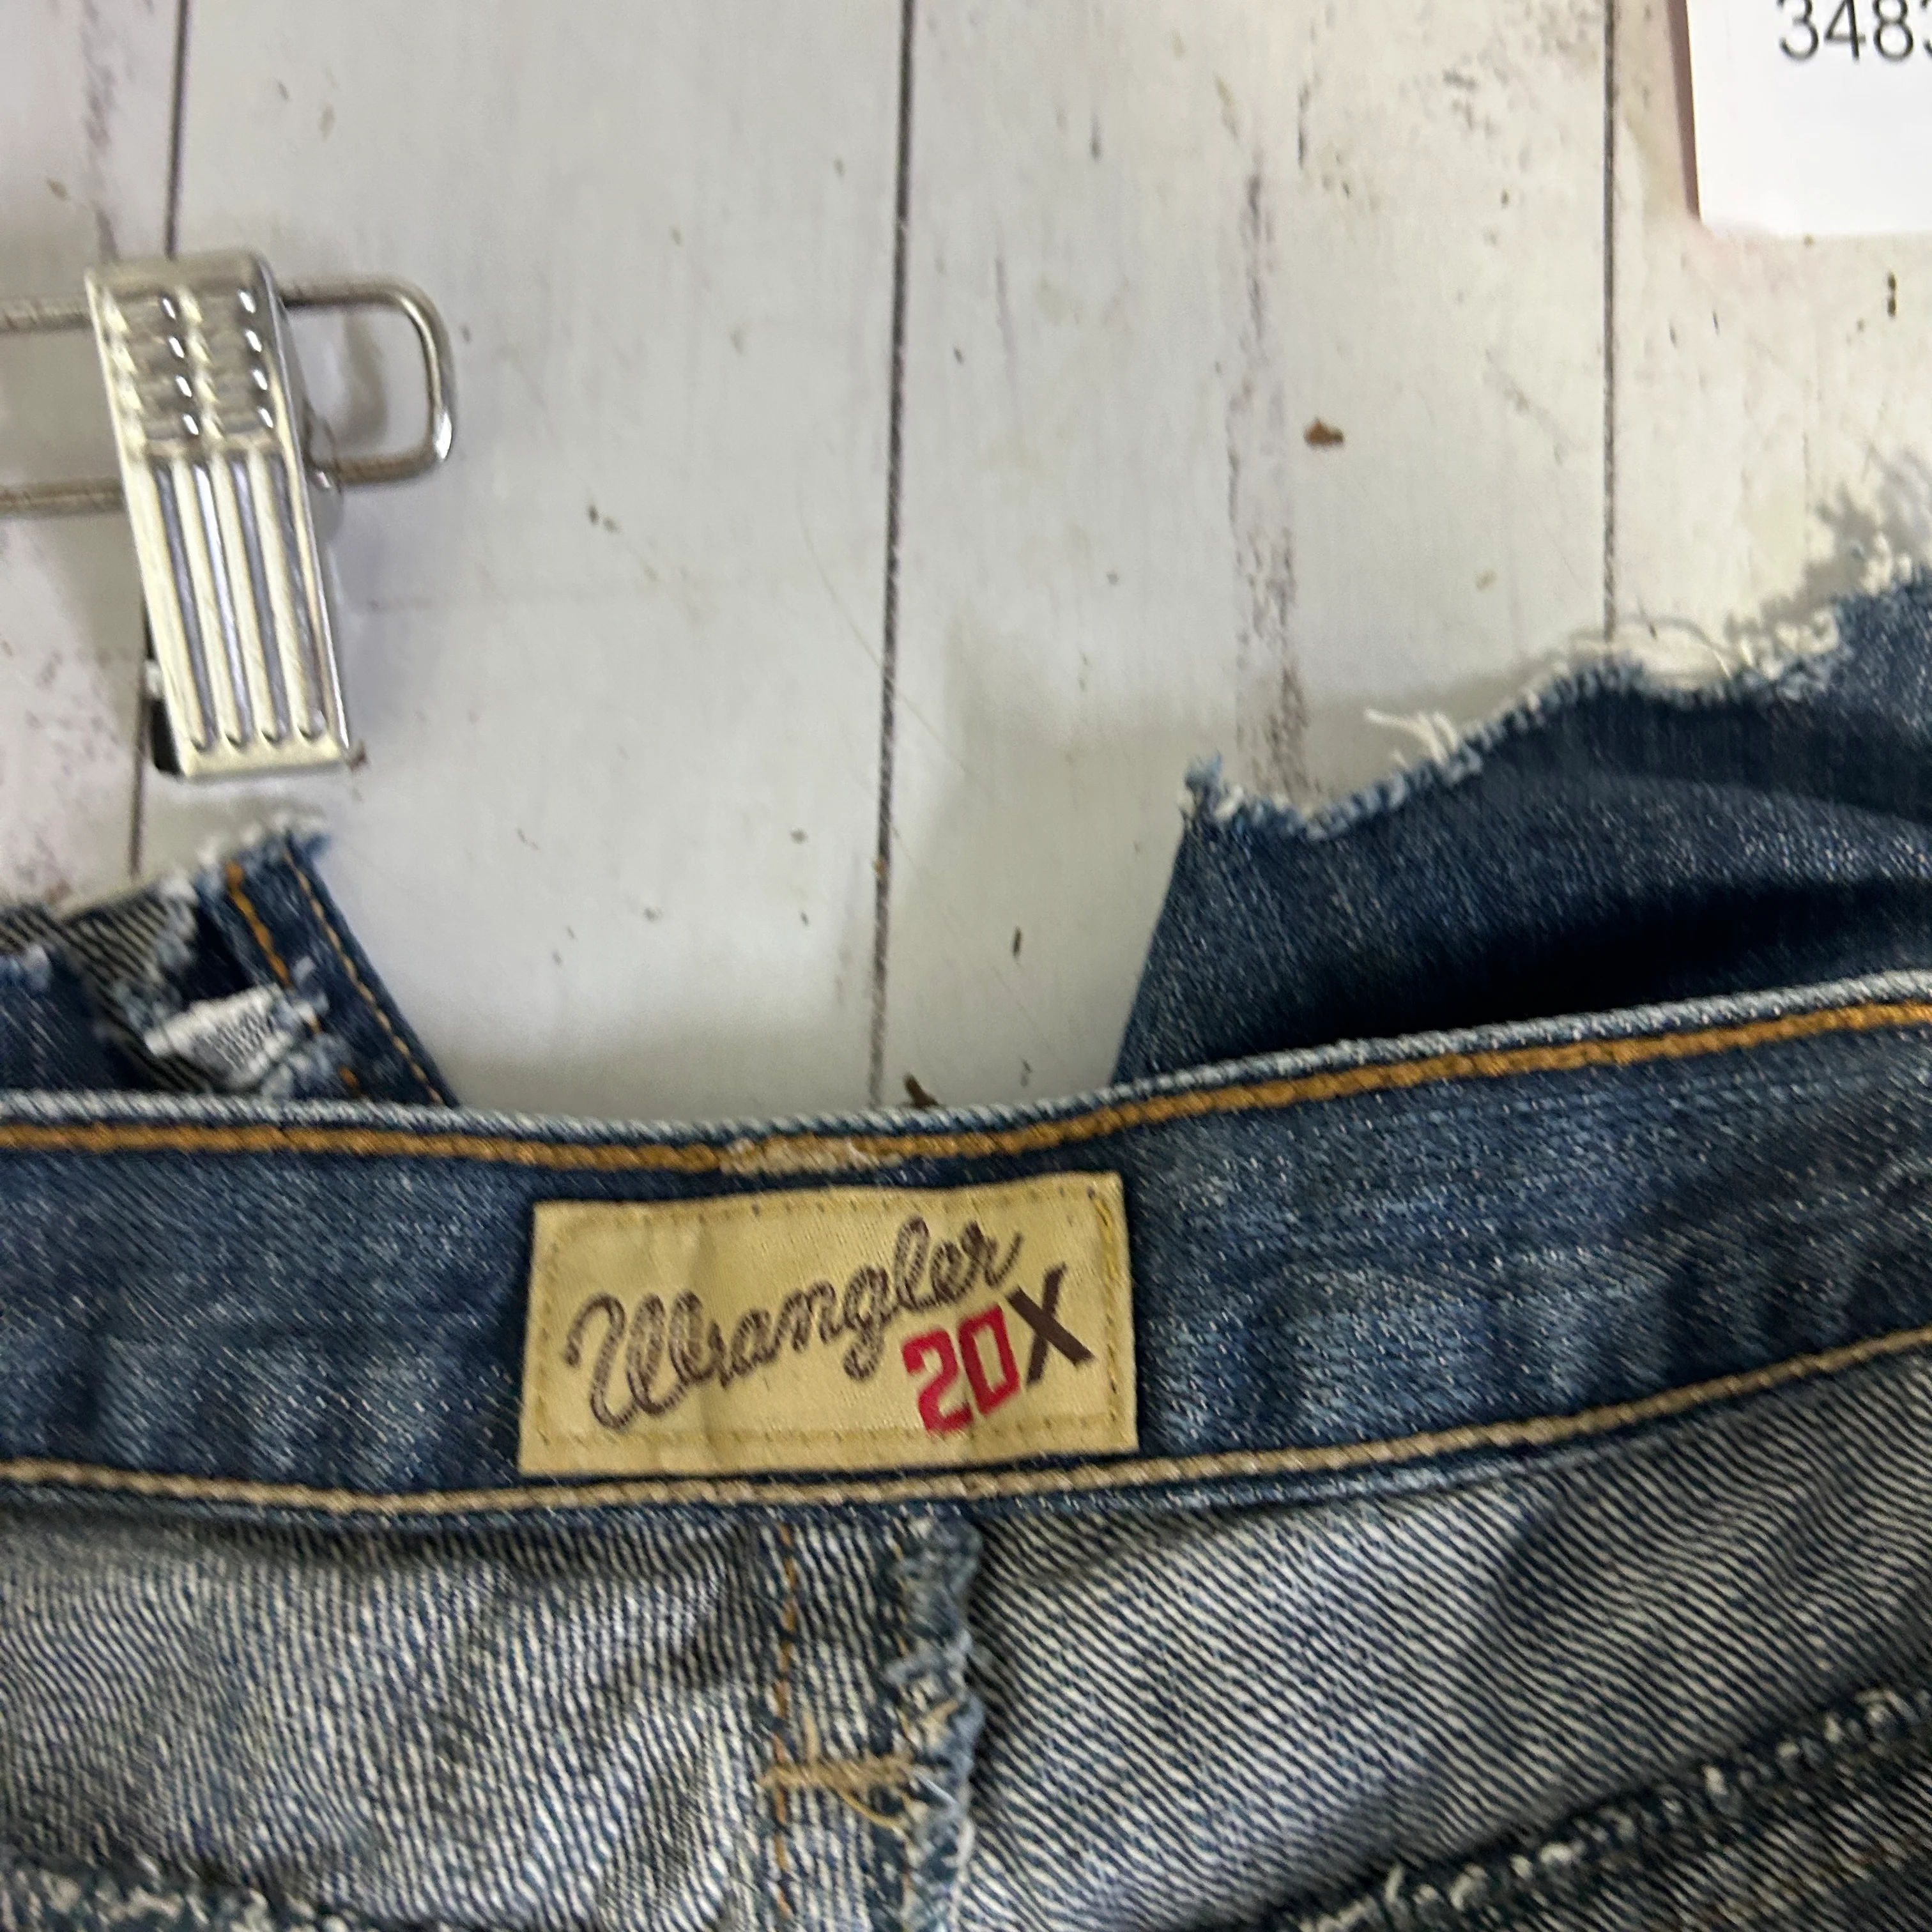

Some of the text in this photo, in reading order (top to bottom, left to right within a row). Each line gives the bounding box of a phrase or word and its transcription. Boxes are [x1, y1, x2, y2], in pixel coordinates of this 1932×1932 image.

[1777, 0, 1932, 63] 348
[562, 1216, 1022, 1431] Wrangler
[901, 1264, 1094, 1435] 20X
